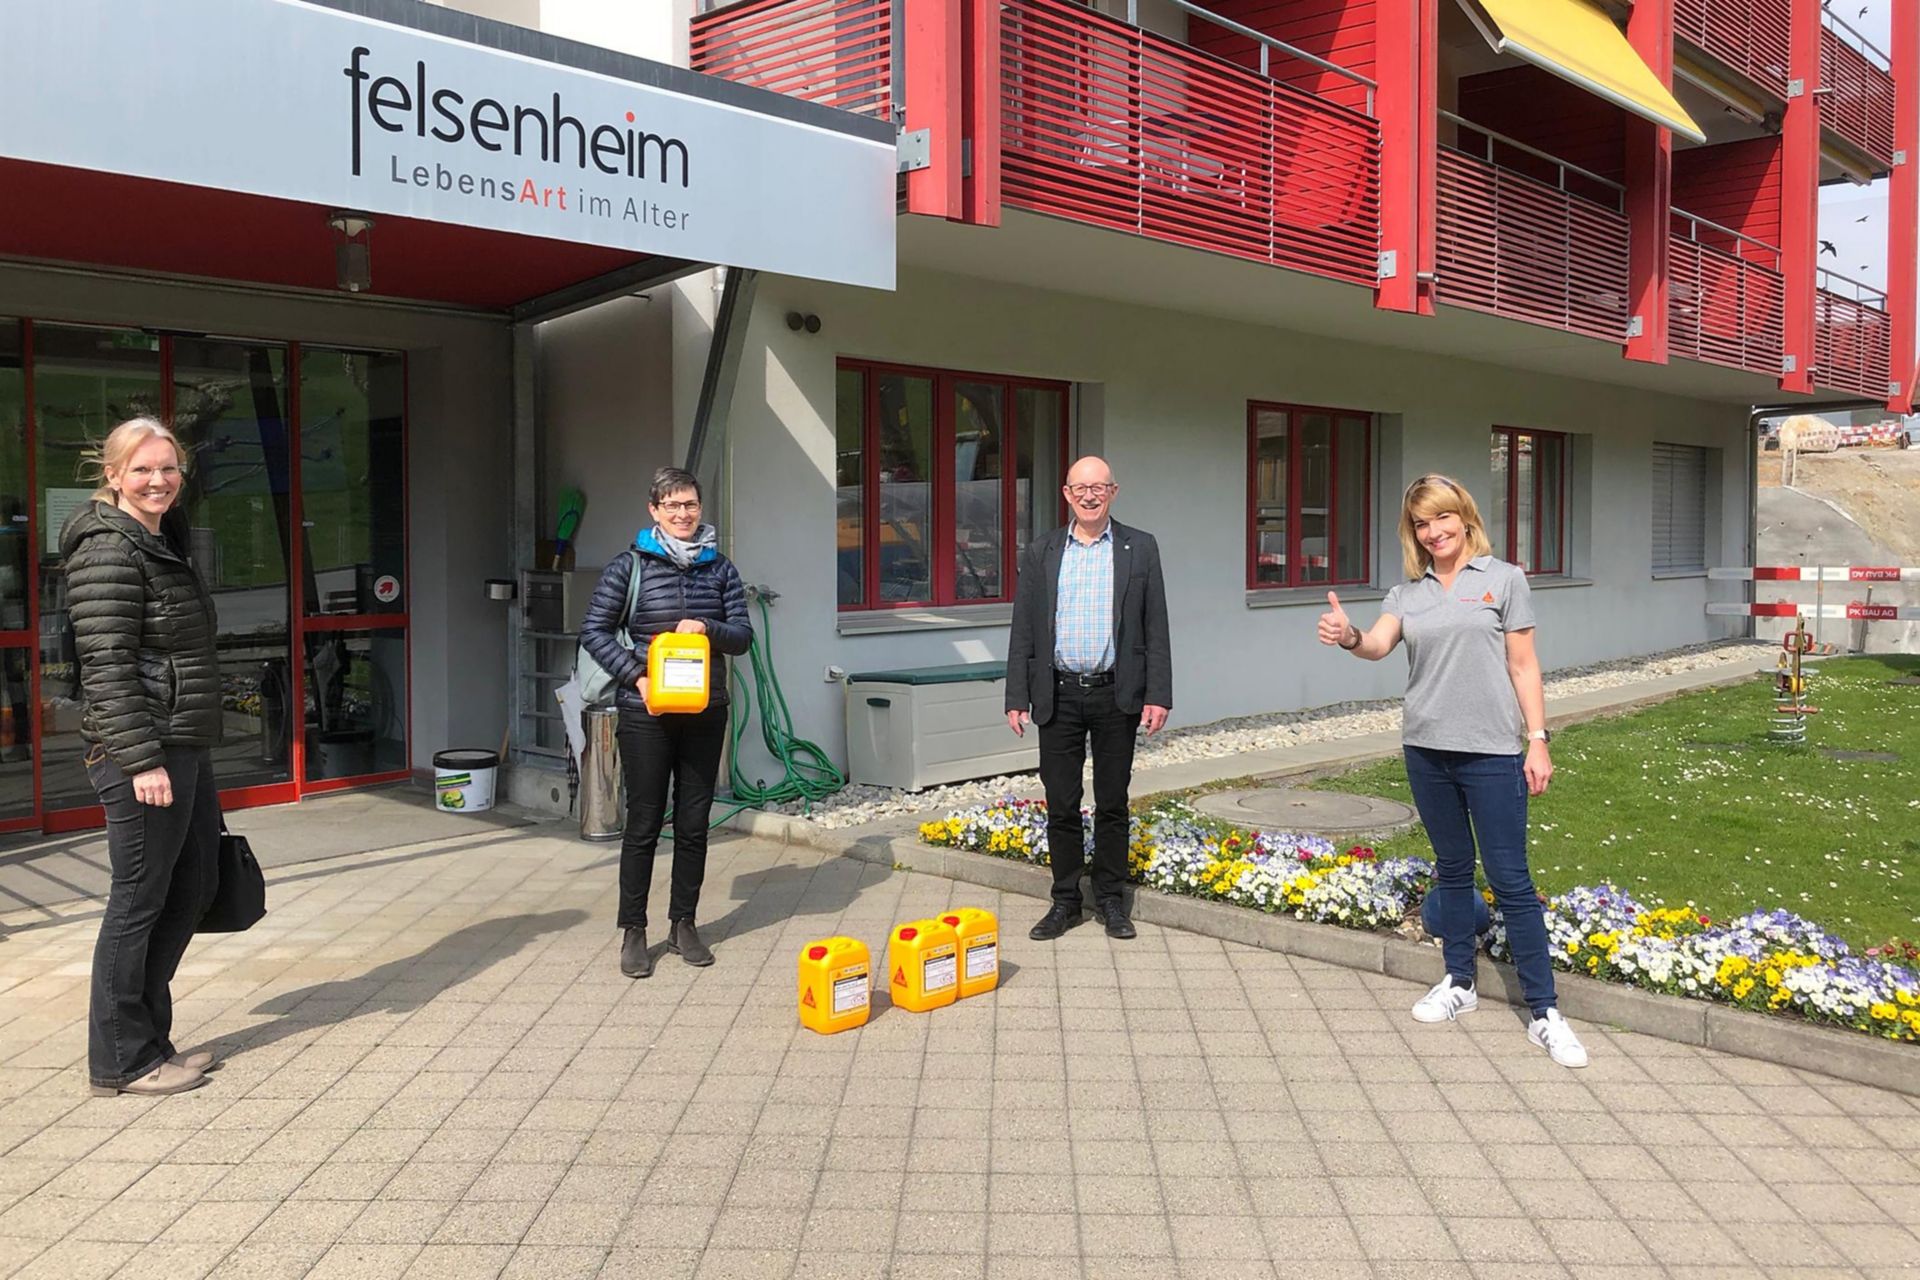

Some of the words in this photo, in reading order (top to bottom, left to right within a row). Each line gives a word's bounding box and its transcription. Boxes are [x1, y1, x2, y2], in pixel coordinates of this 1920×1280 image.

[343, 46, 690, 188] felsenheim
[391, 155, 568, 210] LebensArt
[578, 187, 612, 218] im
[623, 197, 690, 231] Alter
[1849, 608, 1861, 616] PK
[1862, 608, 1880, 616] BAU
[1881, 609, 1894, 617] AG
